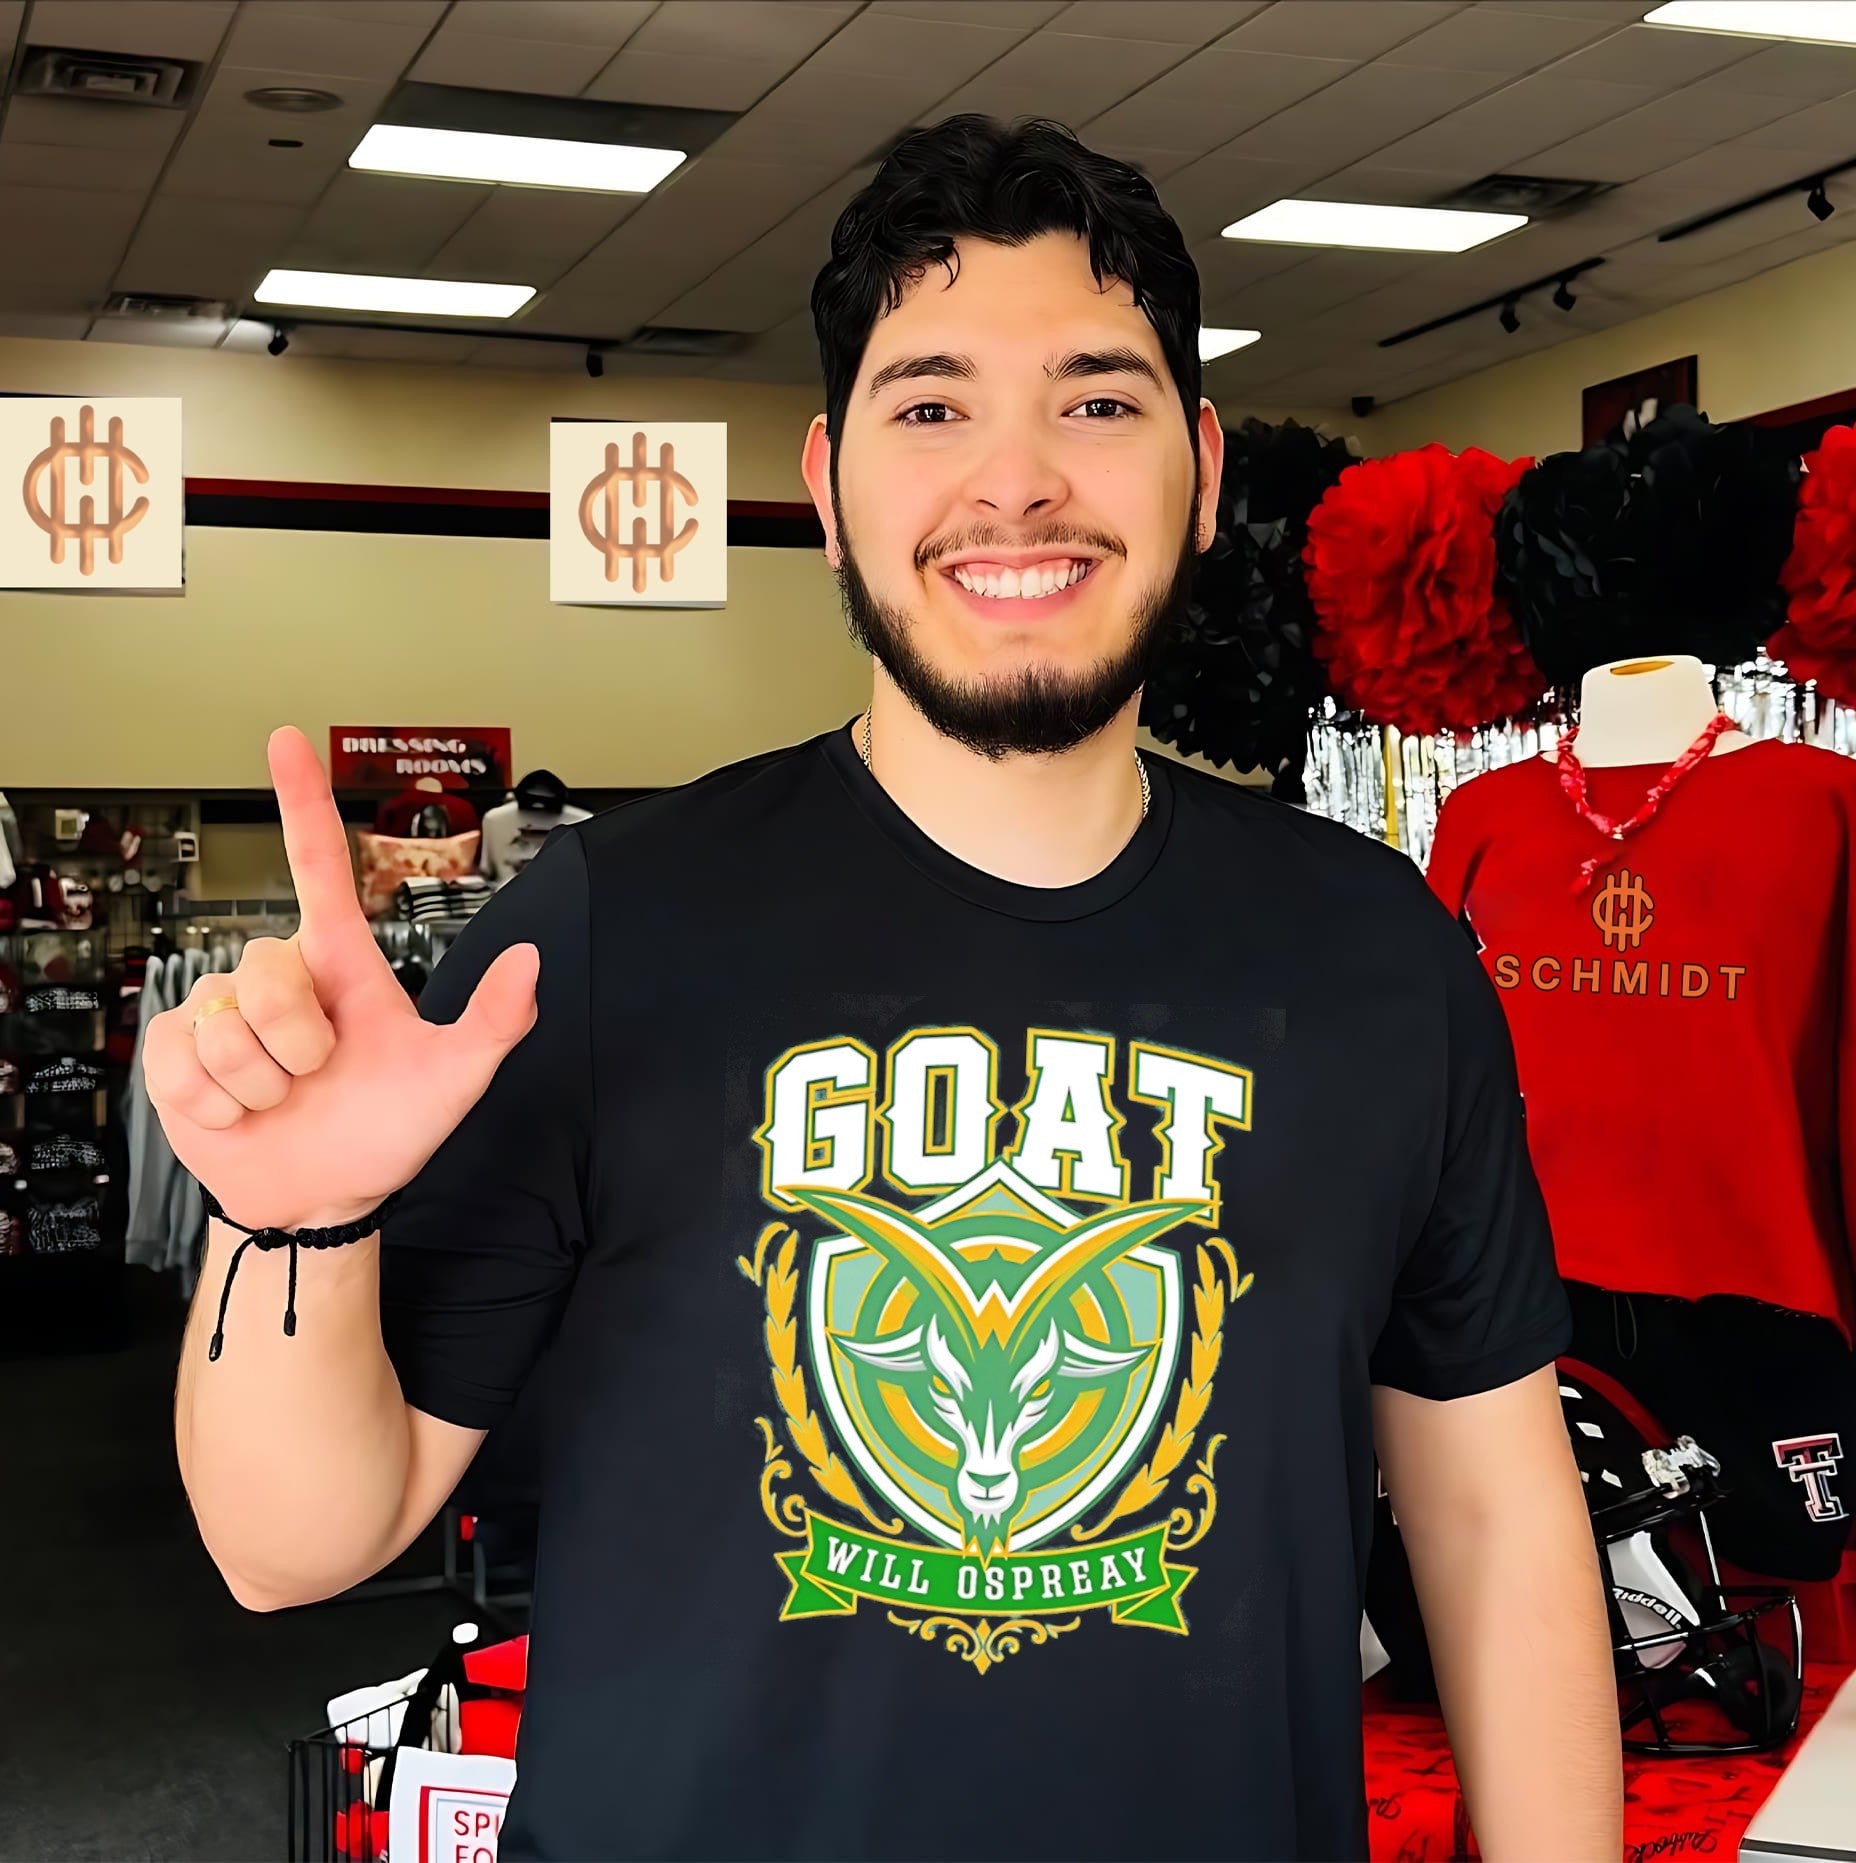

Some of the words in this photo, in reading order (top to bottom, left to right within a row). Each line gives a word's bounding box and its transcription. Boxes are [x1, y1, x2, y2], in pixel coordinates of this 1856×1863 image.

[342, 737, 467, 753] DRESSING
[396, 758, 488, 775] ROOMS
[1494, 953, 1746, 1001] SCHMIDT
[753, 1026, 1253, 1228] GOAT
[827, 1536, 929, 1594] WILL
[957, 1547, 1148, 1601] OSPREAY
